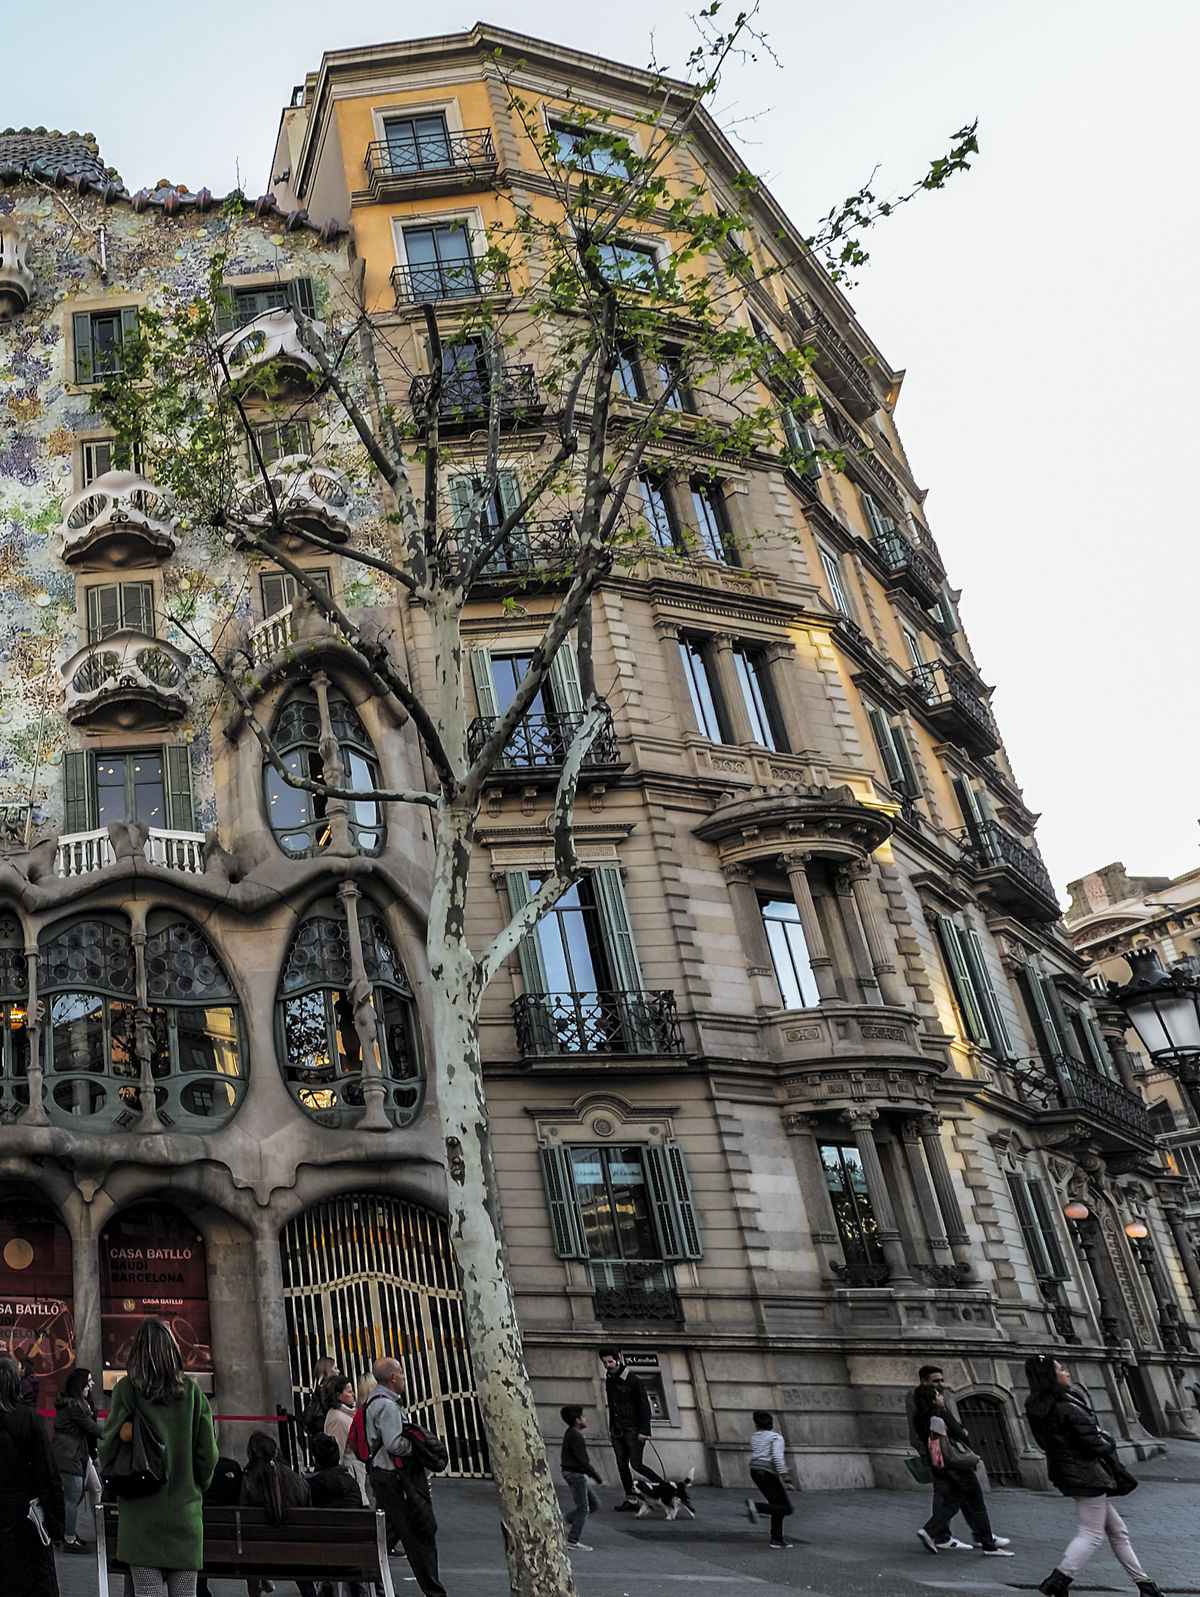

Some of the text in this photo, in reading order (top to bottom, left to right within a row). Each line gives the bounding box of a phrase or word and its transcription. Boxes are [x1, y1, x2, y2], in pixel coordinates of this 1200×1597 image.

[110, 1247, 191, 1259] CASA BATLLÓ
[111, 1273, 184, 1283] BARCELONA
[15, 1303, 59, 1315] BATLLÓ
